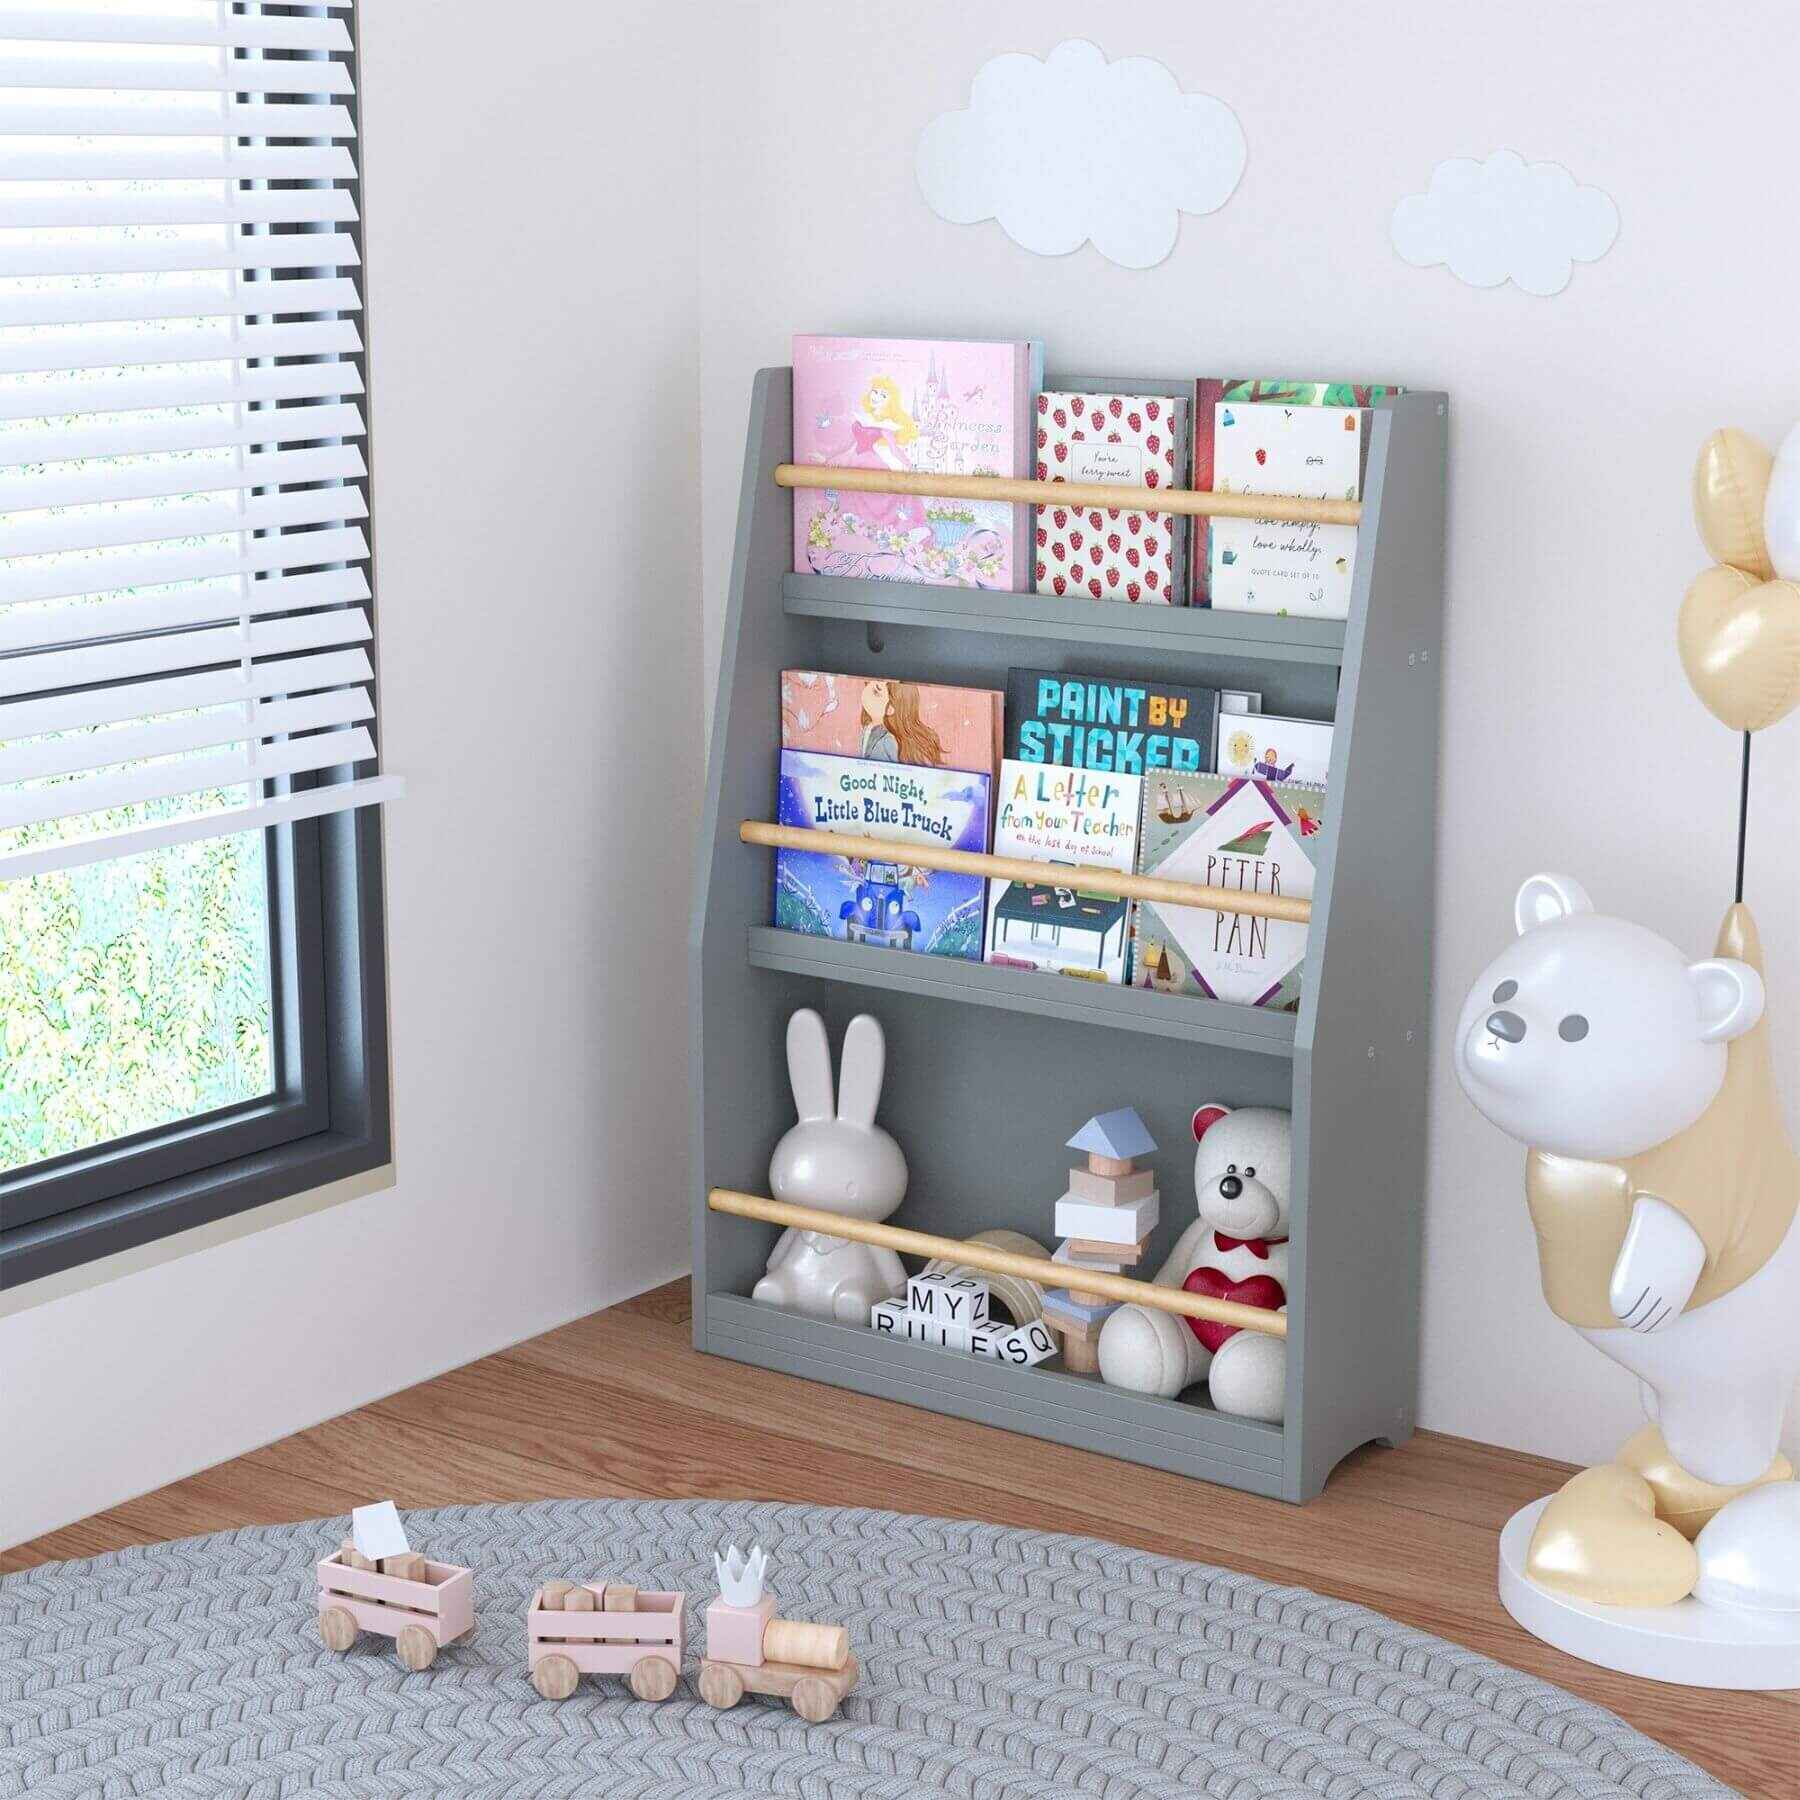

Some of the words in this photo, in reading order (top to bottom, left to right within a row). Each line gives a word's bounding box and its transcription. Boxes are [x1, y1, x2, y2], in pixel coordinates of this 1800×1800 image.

[1252, 535, 1277, 549] love
[1037, 678, 1146, 727] PAINT
[1149, 695, 1188, 728] BY
[840, 774, 877, 791] Good
[882, 775, 928, 805] Night,
[1014, 774, 1028, 801] A
[1037, 771, 1120, 809] Letter
[814, 796, 859, 823] Little
[863, 798, 898, 824] Blue
[901, 803, 953, 841] Truck
[1001, 803, 1033, 829] from
[1071, 811, 1133, 836] Teacher
[1028, 834, 1041, 845] the
[1045, 835, 1061, 848] last
[1065, 839, 1078, 854] day
[1213, 911, 1269, 959] PAN
